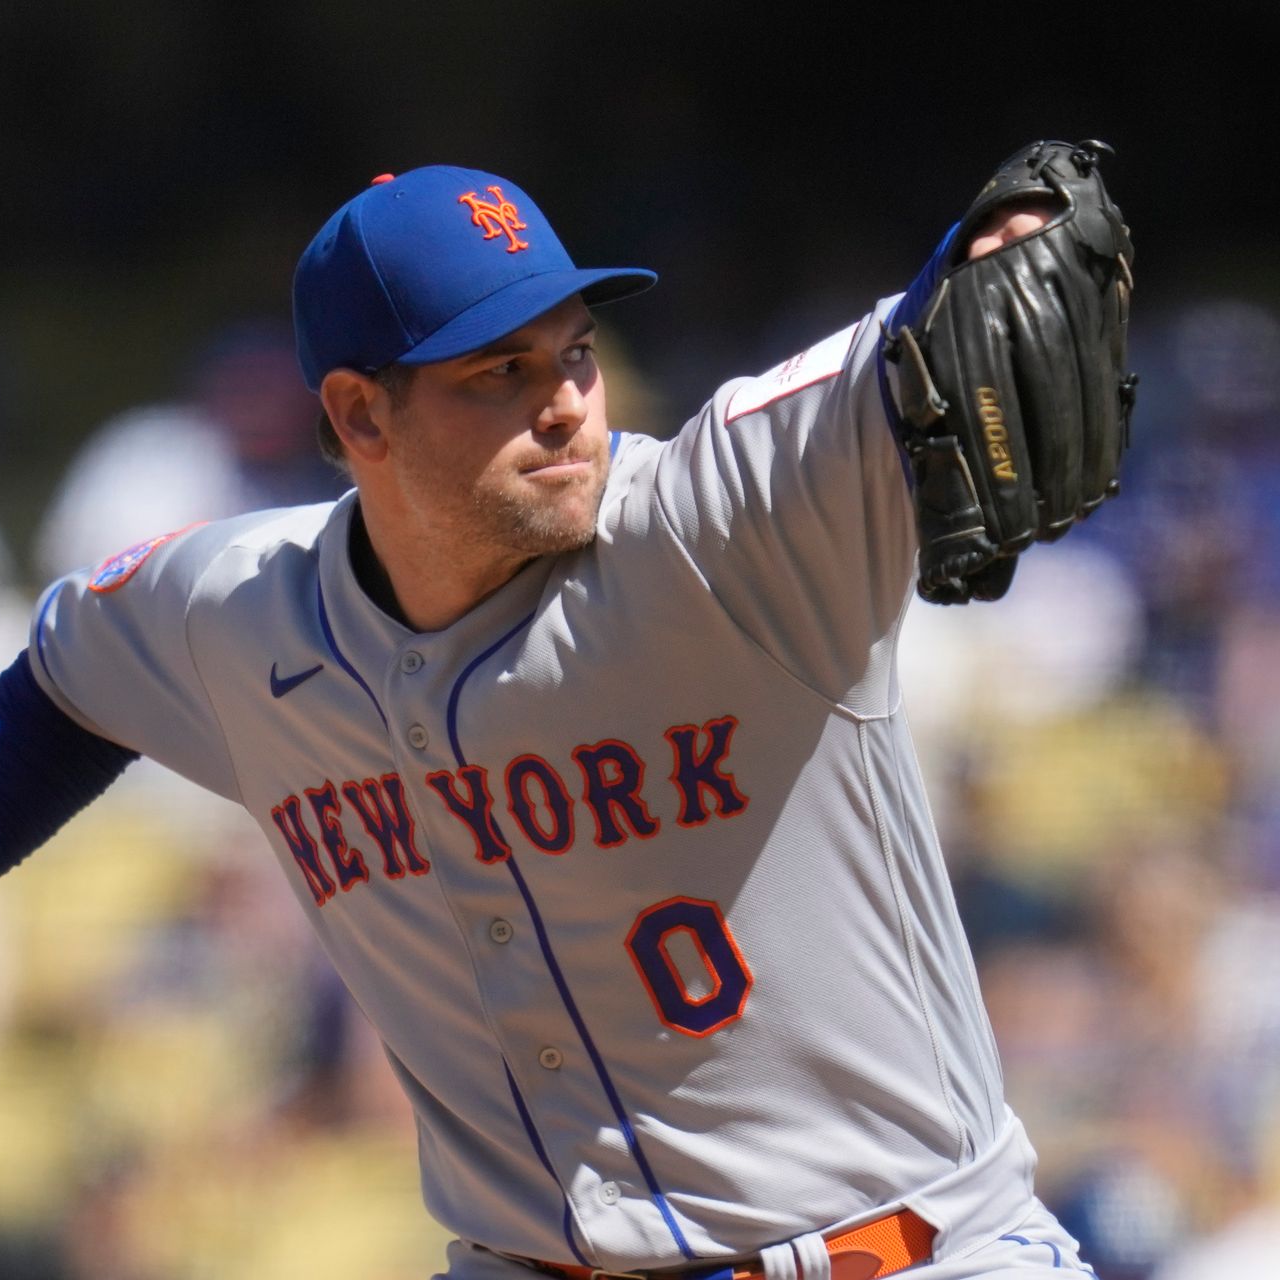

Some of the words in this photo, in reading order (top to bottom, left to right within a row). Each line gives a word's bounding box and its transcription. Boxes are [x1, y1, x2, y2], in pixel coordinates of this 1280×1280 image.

[976, 387, 1018, 482] A2000
[270, 773, 430, 907] NEW
[425, 715, 750, 865] YORK
[624, 895, 755, 1039] 0
